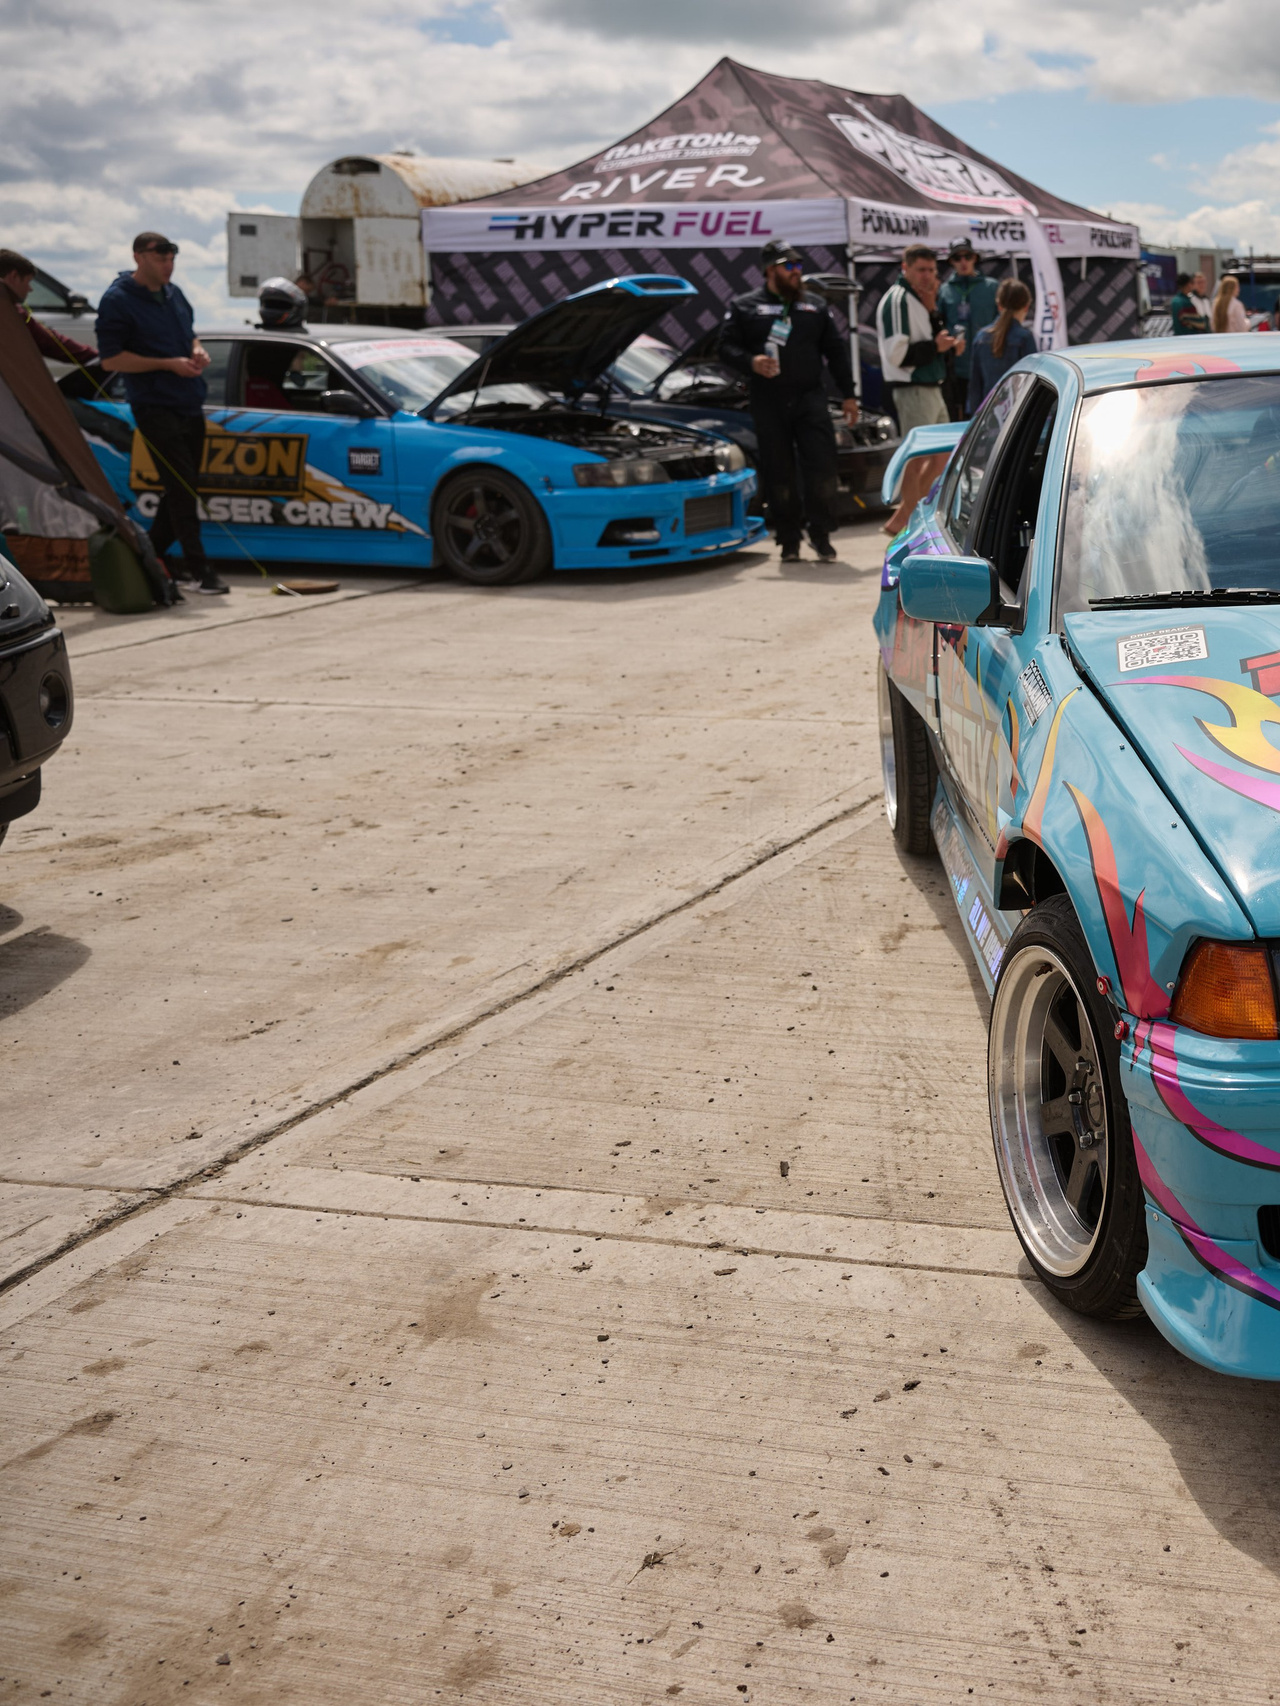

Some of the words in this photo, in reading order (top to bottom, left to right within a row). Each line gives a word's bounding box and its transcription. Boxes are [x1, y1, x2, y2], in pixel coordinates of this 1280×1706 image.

[558, 164, 765, 201] RIVER
[493, 211, 665, 240] HYPER
[673, 211, 772, 237] FUEL
[282, 501, 393, 528] CREW
[1130, 629, 1157, 639] DRIFT
[1158, 626, 1190, 634] READY
